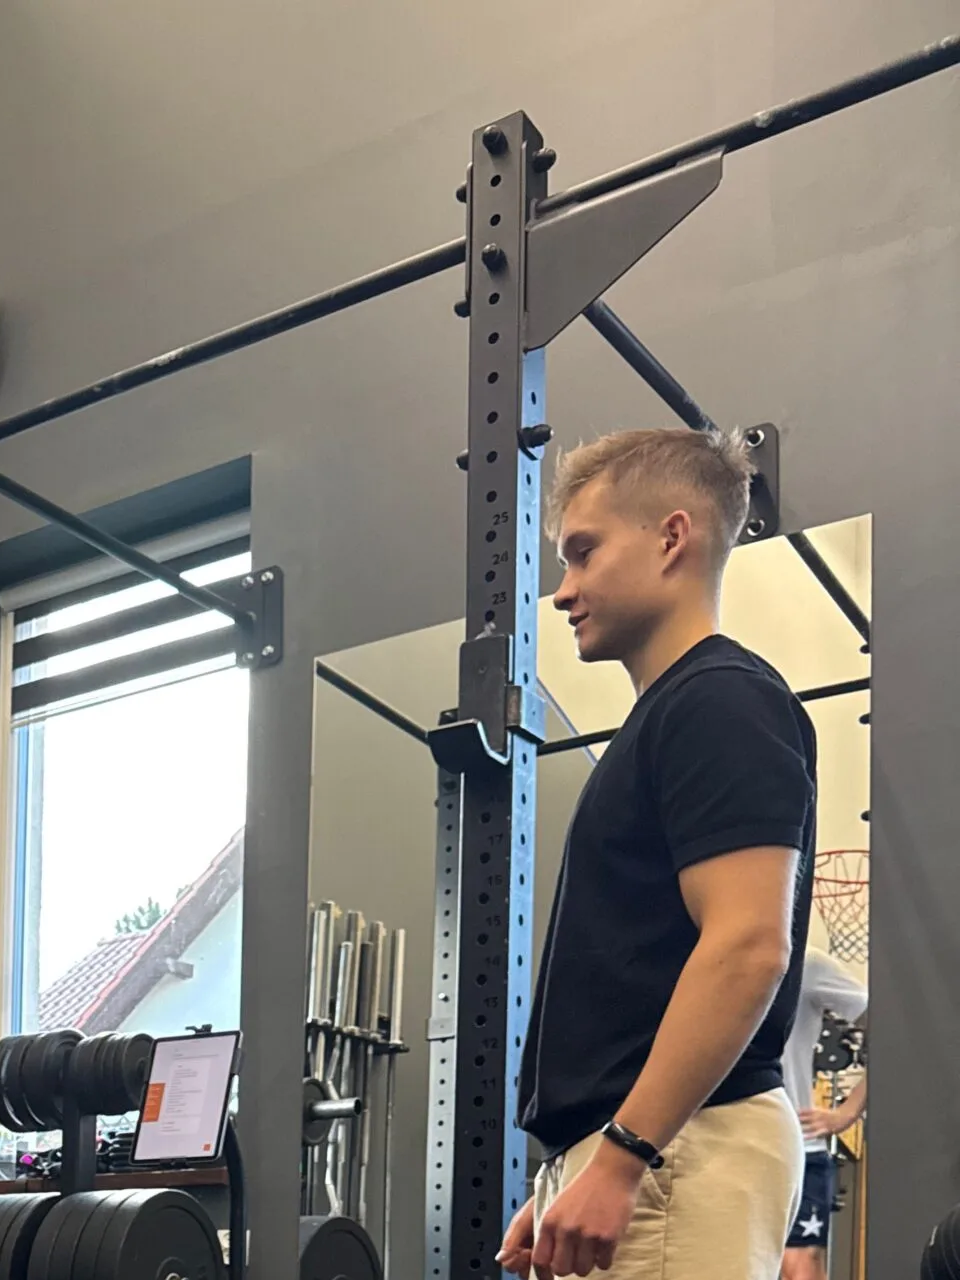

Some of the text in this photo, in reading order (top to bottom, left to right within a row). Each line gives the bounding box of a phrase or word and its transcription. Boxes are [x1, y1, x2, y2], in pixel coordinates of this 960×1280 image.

[492, 511, 509, 526] 25
[492, 550, 509, 566] 24
[491, 591, 508, 606] 23
[487, 832, 503, 847] 17
[485, 915, 501, 927] 15
[481, 1037, 499, 1049] 12
[481, 1076, 496, 1090] 11
[480, 1117, 497, 1130] 10
